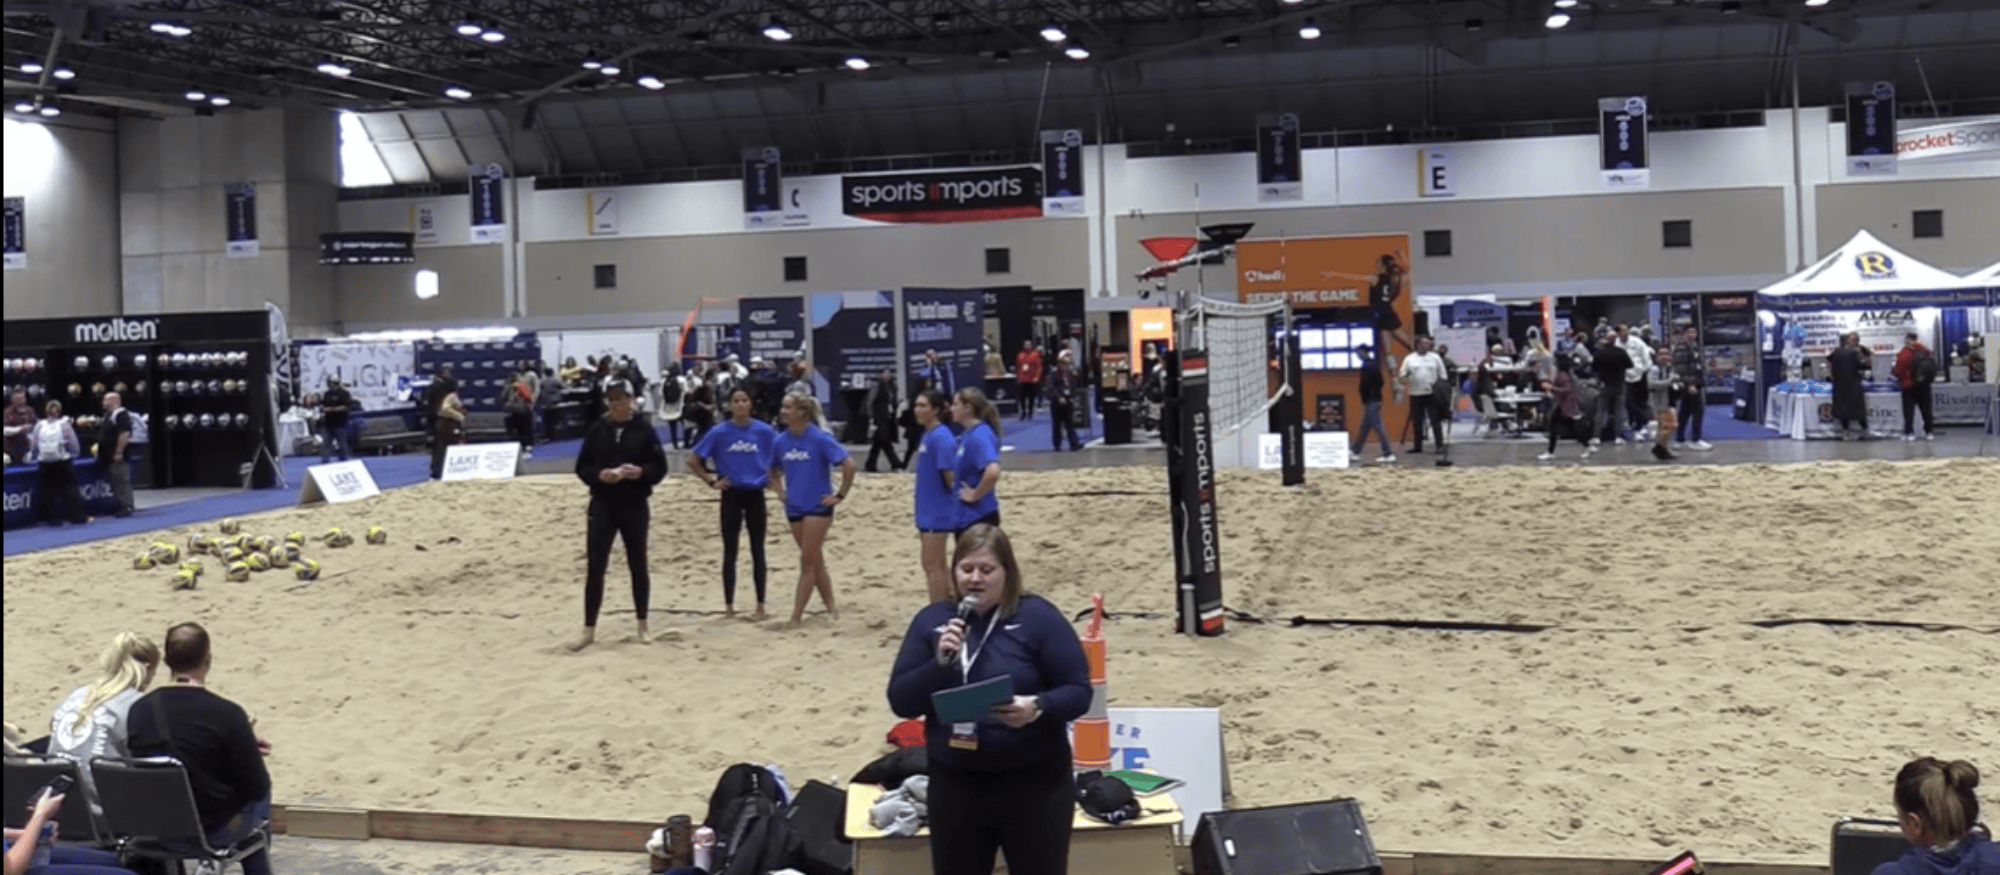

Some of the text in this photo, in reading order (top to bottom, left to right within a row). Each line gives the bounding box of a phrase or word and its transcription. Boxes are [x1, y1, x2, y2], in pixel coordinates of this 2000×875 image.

[1432, 166, 1446, 190] E
[852, 181, 926, 207] sports
[1291, 290, 1317, 303] THE
[1320, 288, 1359, 302] GAME
[75, 318, 158, 343] molten
[1264, 445, 1283, 456] LA
[3, 490, 31, 512] ten
[1199, 502, 1217, 573] sports
